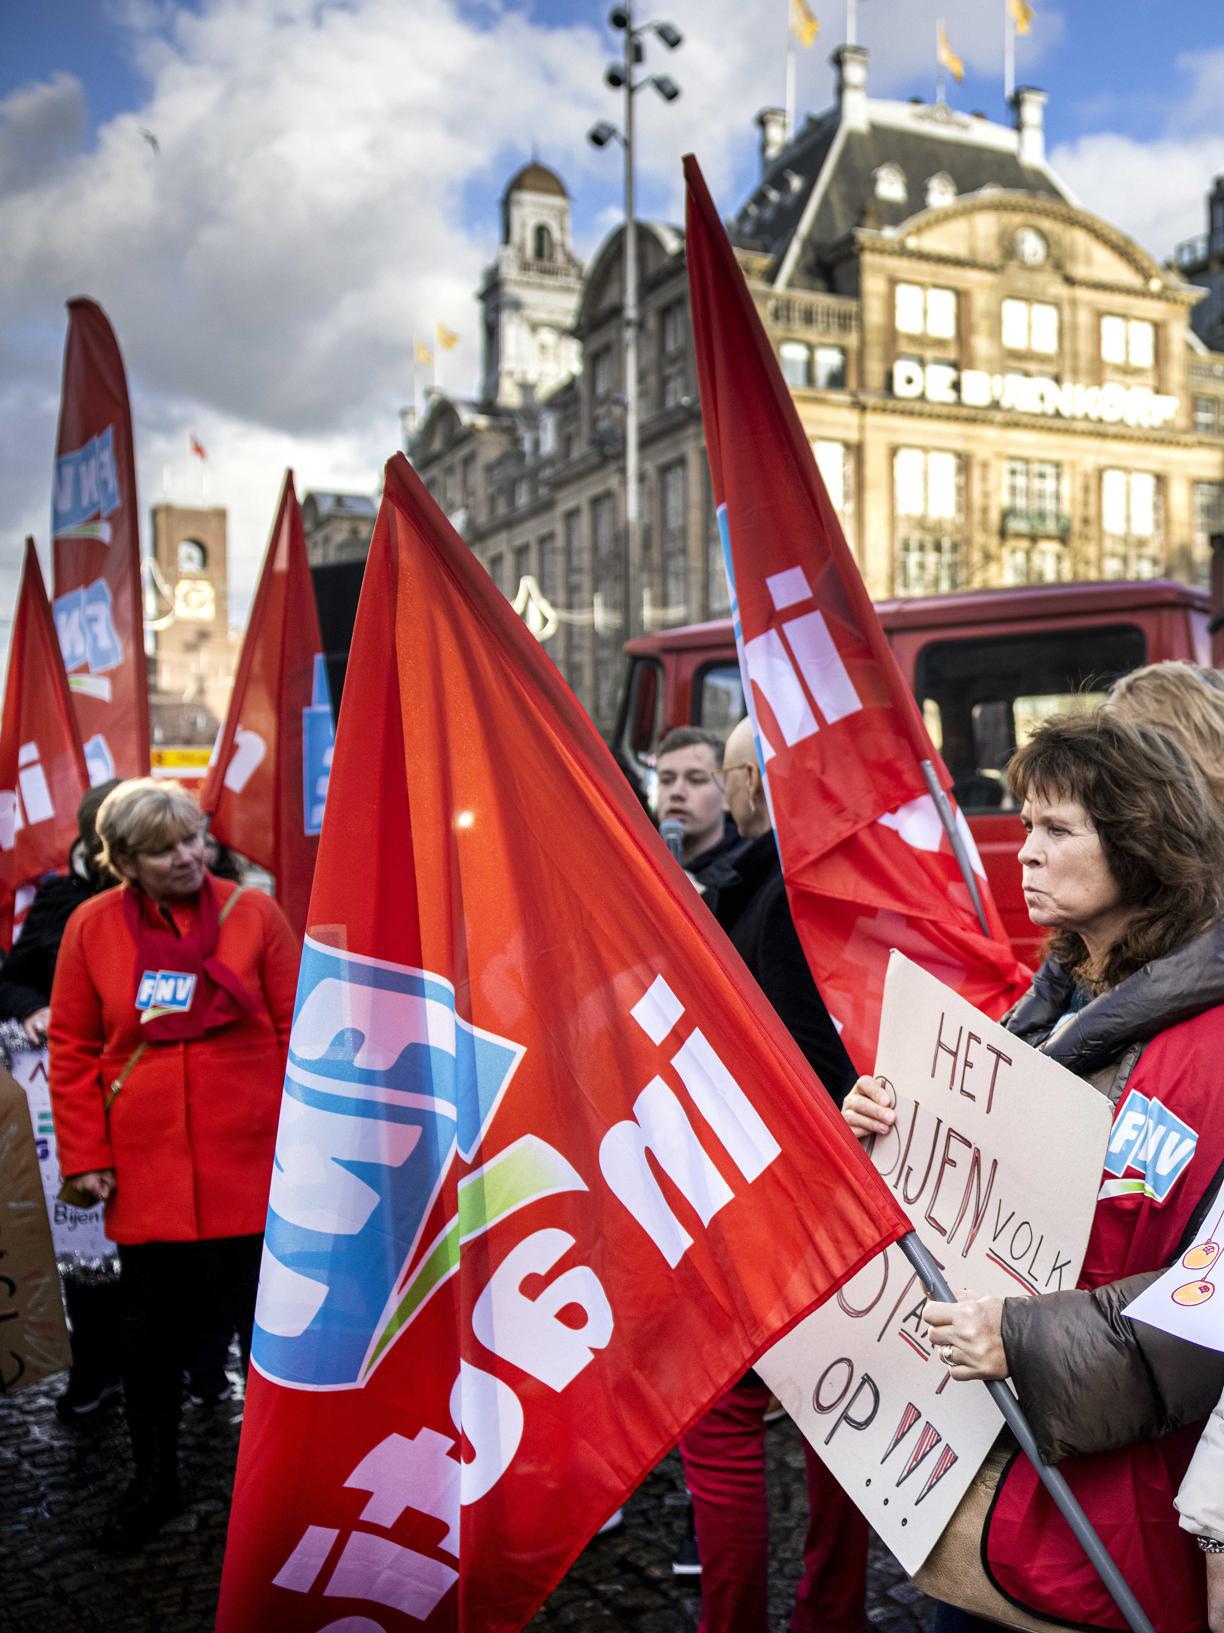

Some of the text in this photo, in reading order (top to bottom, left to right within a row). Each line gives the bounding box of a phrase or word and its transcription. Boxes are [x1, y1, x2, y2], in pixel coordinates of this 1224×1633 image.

[893, 359, 958, 403] DE
[140, 978, 192, 1002] FNV
[931, 1012, 1012, 1114] HET
[1108, 1111, 1197, 1176] FNV
